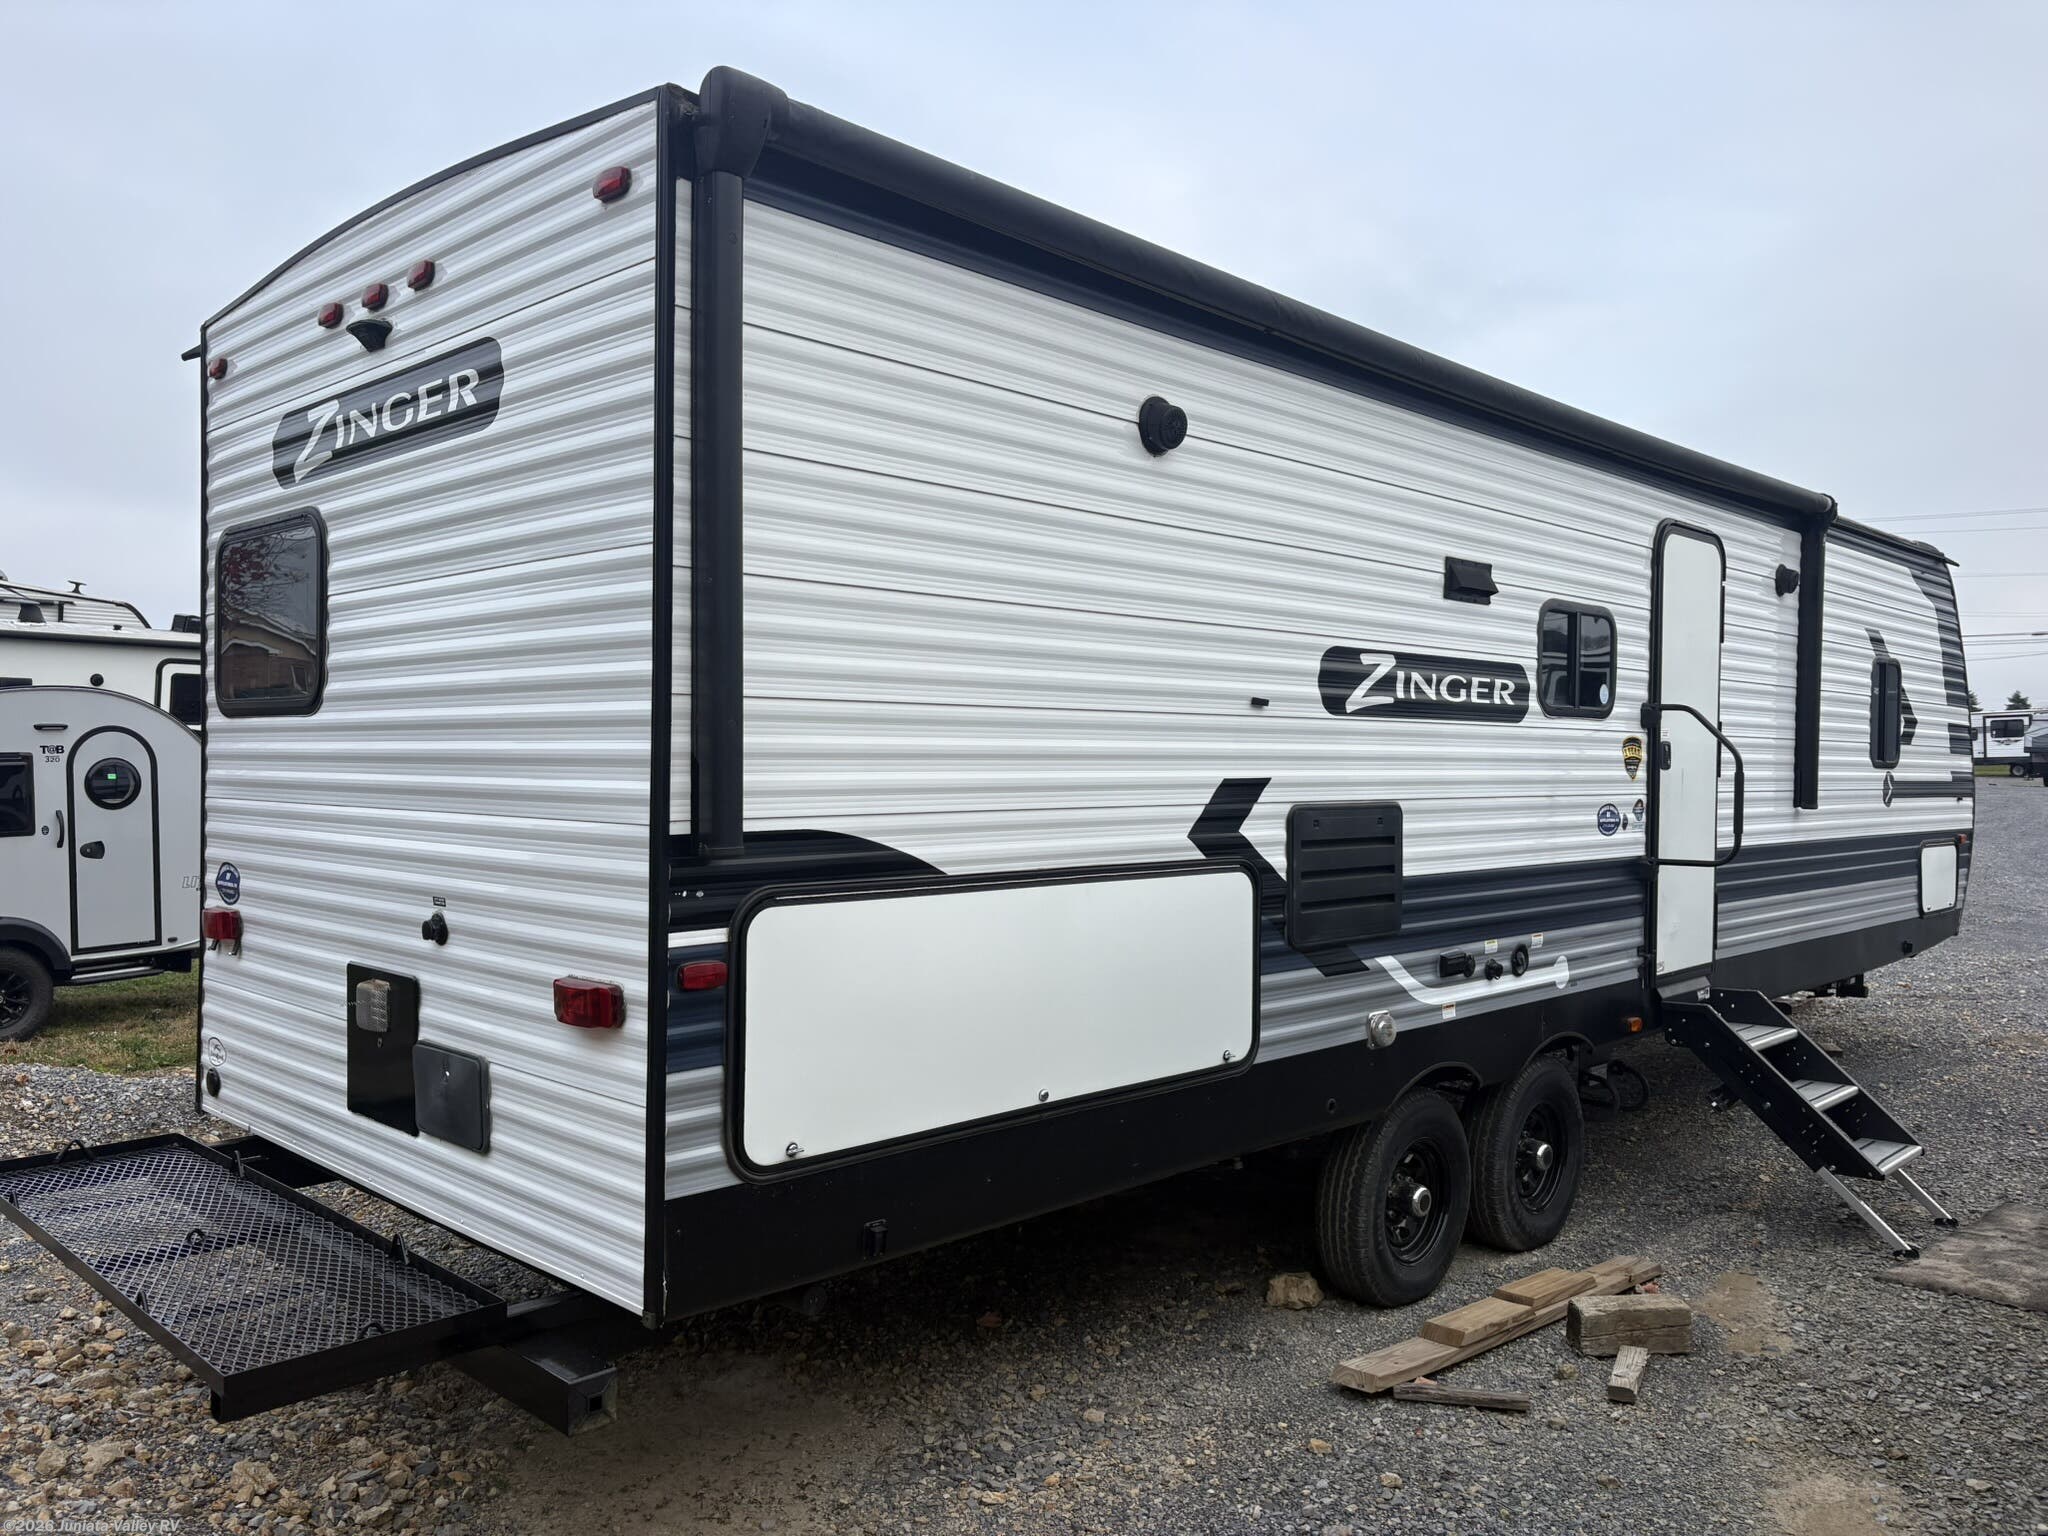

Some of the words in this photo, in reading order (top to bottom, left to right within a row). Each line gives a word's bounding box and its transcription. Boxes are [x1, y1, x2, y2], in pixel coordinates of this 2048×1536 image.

[293, 369, 479, 483] ZINGER
[1345, 653, 1516, 714] ZINGER
[40, 745, 65, 754] T@B
